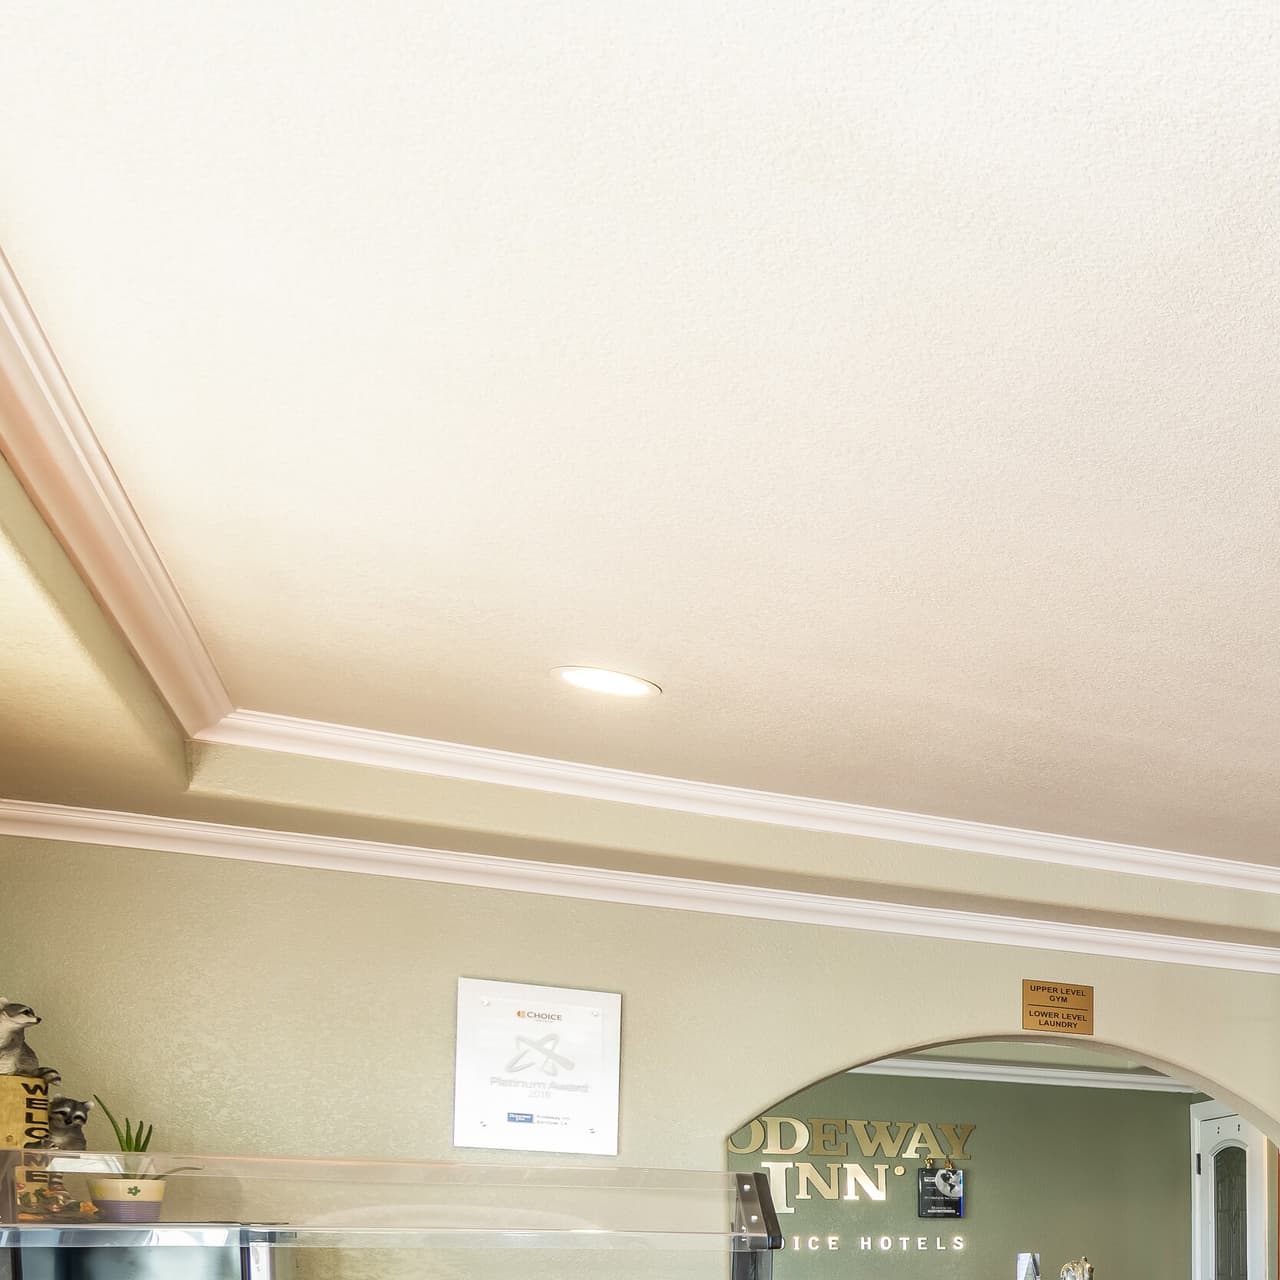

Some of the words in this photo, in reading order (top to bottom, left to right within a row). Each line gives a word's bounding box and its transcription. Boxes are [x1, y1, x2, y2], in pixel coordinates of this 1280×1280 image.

[1030, 985, 1058, 994] UPPER
[1060, 988, 1086, 997] LEVEL
[1049, 995, 1068, 1003] GYM
[526, 1011, 562, 1021] CHOICE
[1029, 1010, 1060, 1019] LOWER
[1061, 1013, 1087, 1022] LEVEL
[1038, 1020, 1078, 1029] LAUNDRY
[761, 1162, 889, 1214] INN
[782, 1236, 840, 1250] ICE
[860, 1236, 964, 1251] HOTELS
